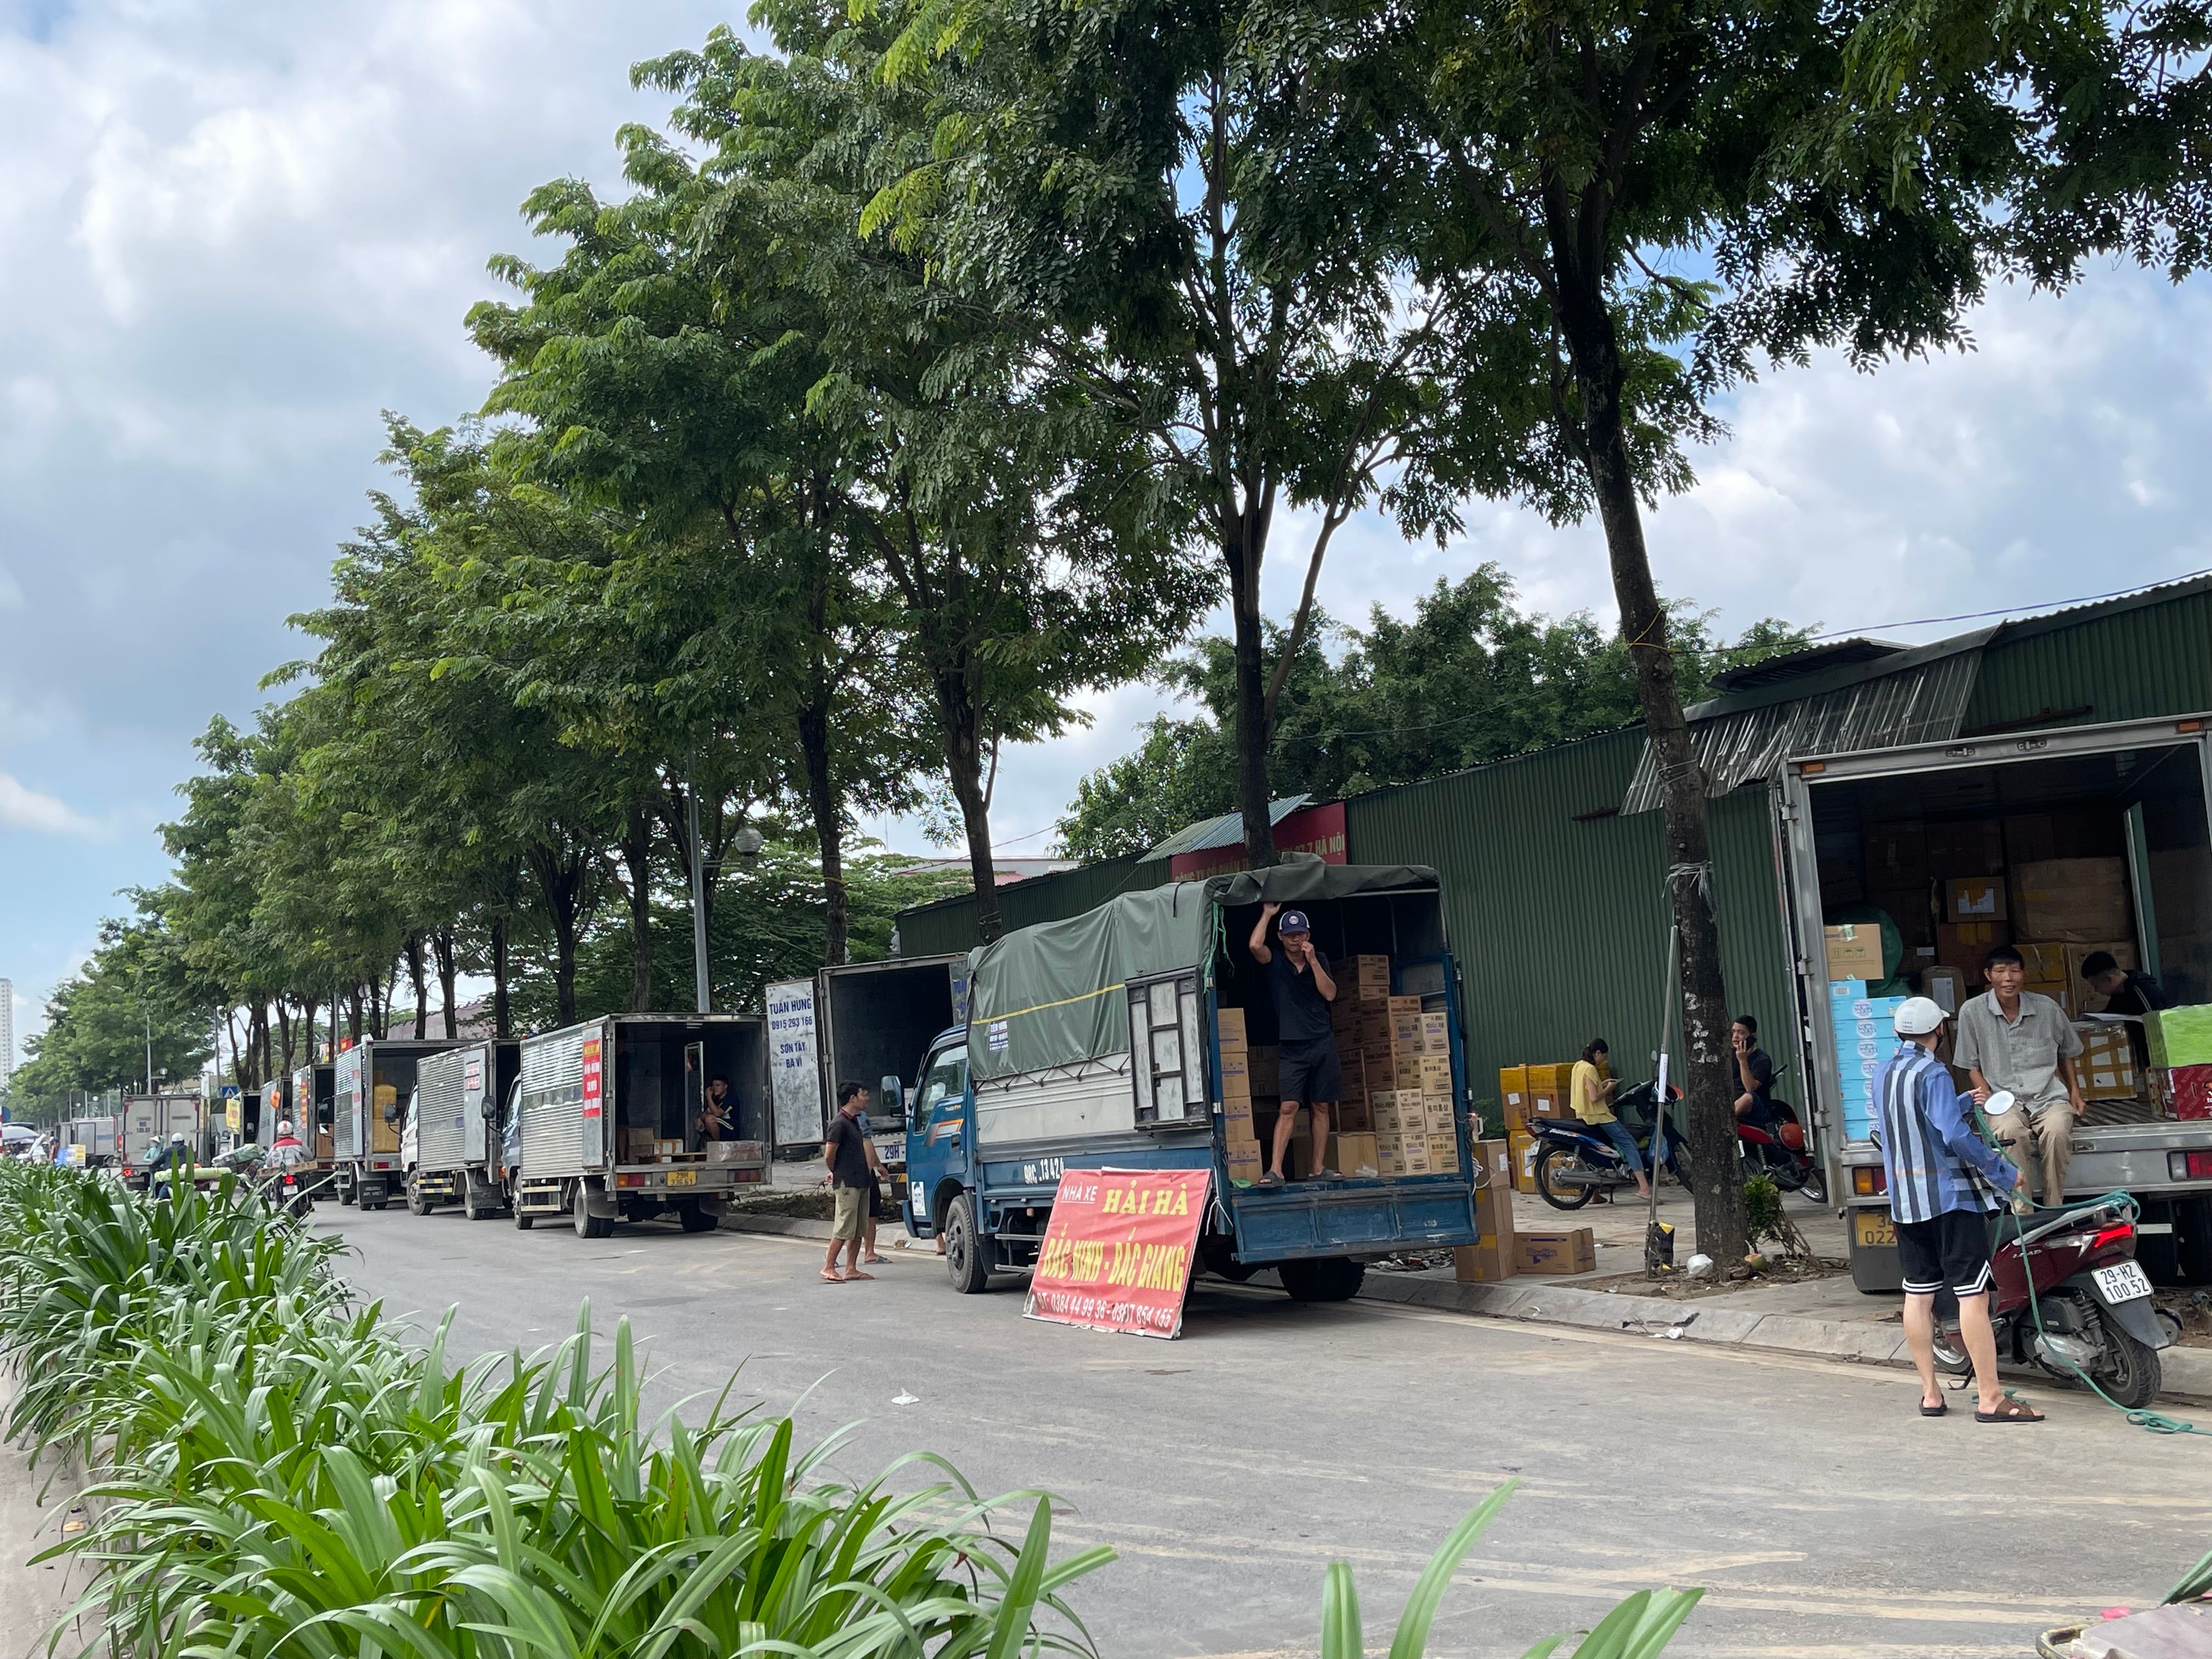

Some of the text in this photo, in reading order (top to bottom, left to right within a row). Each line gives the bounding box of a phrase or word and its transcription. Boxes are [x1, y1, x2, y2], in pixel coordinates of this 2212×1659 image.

[1315, 835, 1327, 856] HÀ
[1329, 831, 1345, 855] NỘI
[772, 1016, 812, 1030] 0915 293 166
[786, 1058, 795, 1068] BA
[884, 1146, 899, 1159] 29H
[1062, 1180, 1188, 1216] NHÀ XE HẢI HÀ
[1040, 1223, 1071, 1279] BẮC
[1070, 1240, 1105, 1282] NINH
[1107, 1226, 1142, 1287] BẮC
[1137, 1244, 1186, 1293] GIANG
[2100, 1264, 2137, 1285] 29-H2
[2106, 1278, 2149, 1300] 100.52
[1051, 1293, 1070, 1313] 0384
[1070, 1295, 1082, 1316] 44
[1081, 1297, 1095, 1317] 99
[1094, 1300, 1107, 1320] 36
[1136, 1305, 1155, 1325] 854
[1154, 1307, 1174, 1328] 155
